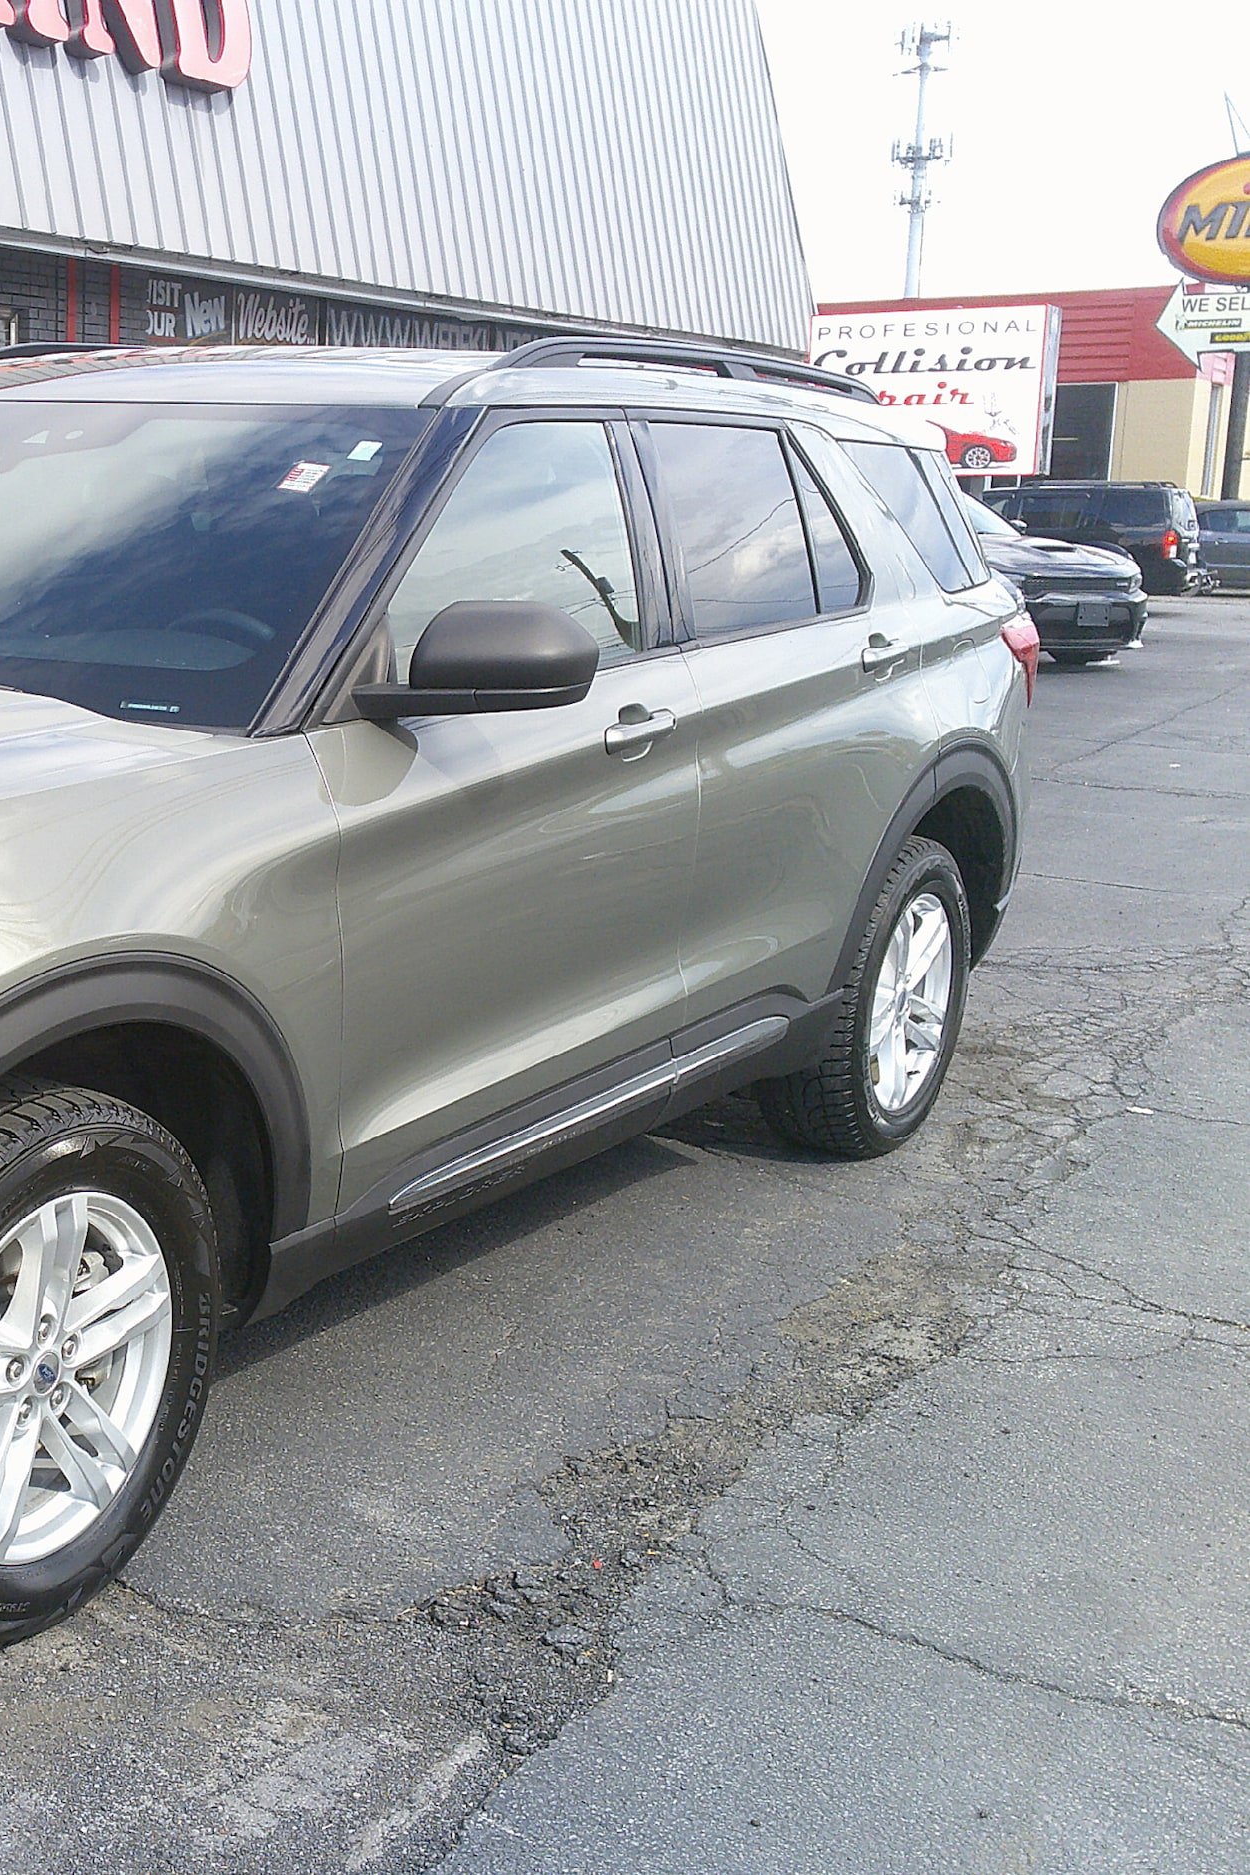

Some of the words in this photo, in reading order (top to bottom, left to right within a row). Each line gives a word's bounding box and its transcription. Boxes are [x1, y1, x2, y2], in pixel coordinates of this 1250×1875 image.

[1182, 297, 1210, 312] WE
[818, 319, 1038, 341] PROFESIONAL
[813, 346, 1037, 376] Collision
[140, 1291, 212, 1523] BRIDGESTONE
